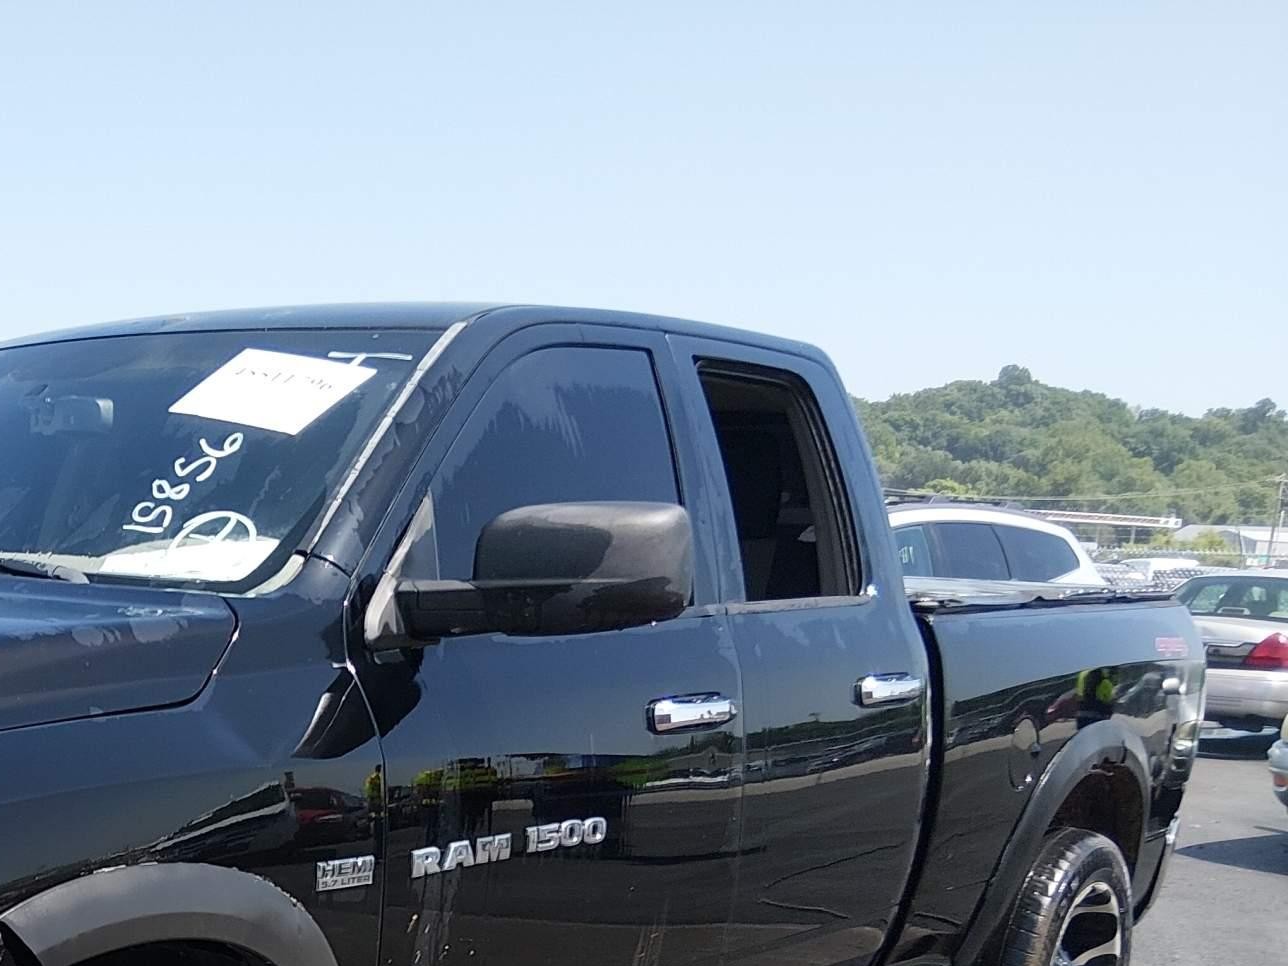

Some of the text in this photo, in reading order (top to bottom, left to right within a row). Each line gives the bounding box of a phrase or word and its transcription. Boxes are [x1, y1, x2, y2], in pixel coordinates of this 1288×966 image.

[411, 817, 608, 879] RAM 1500
[317, 857, 374, 880] HEMI
[320, 875, 371, 889] 5.7 LITER
